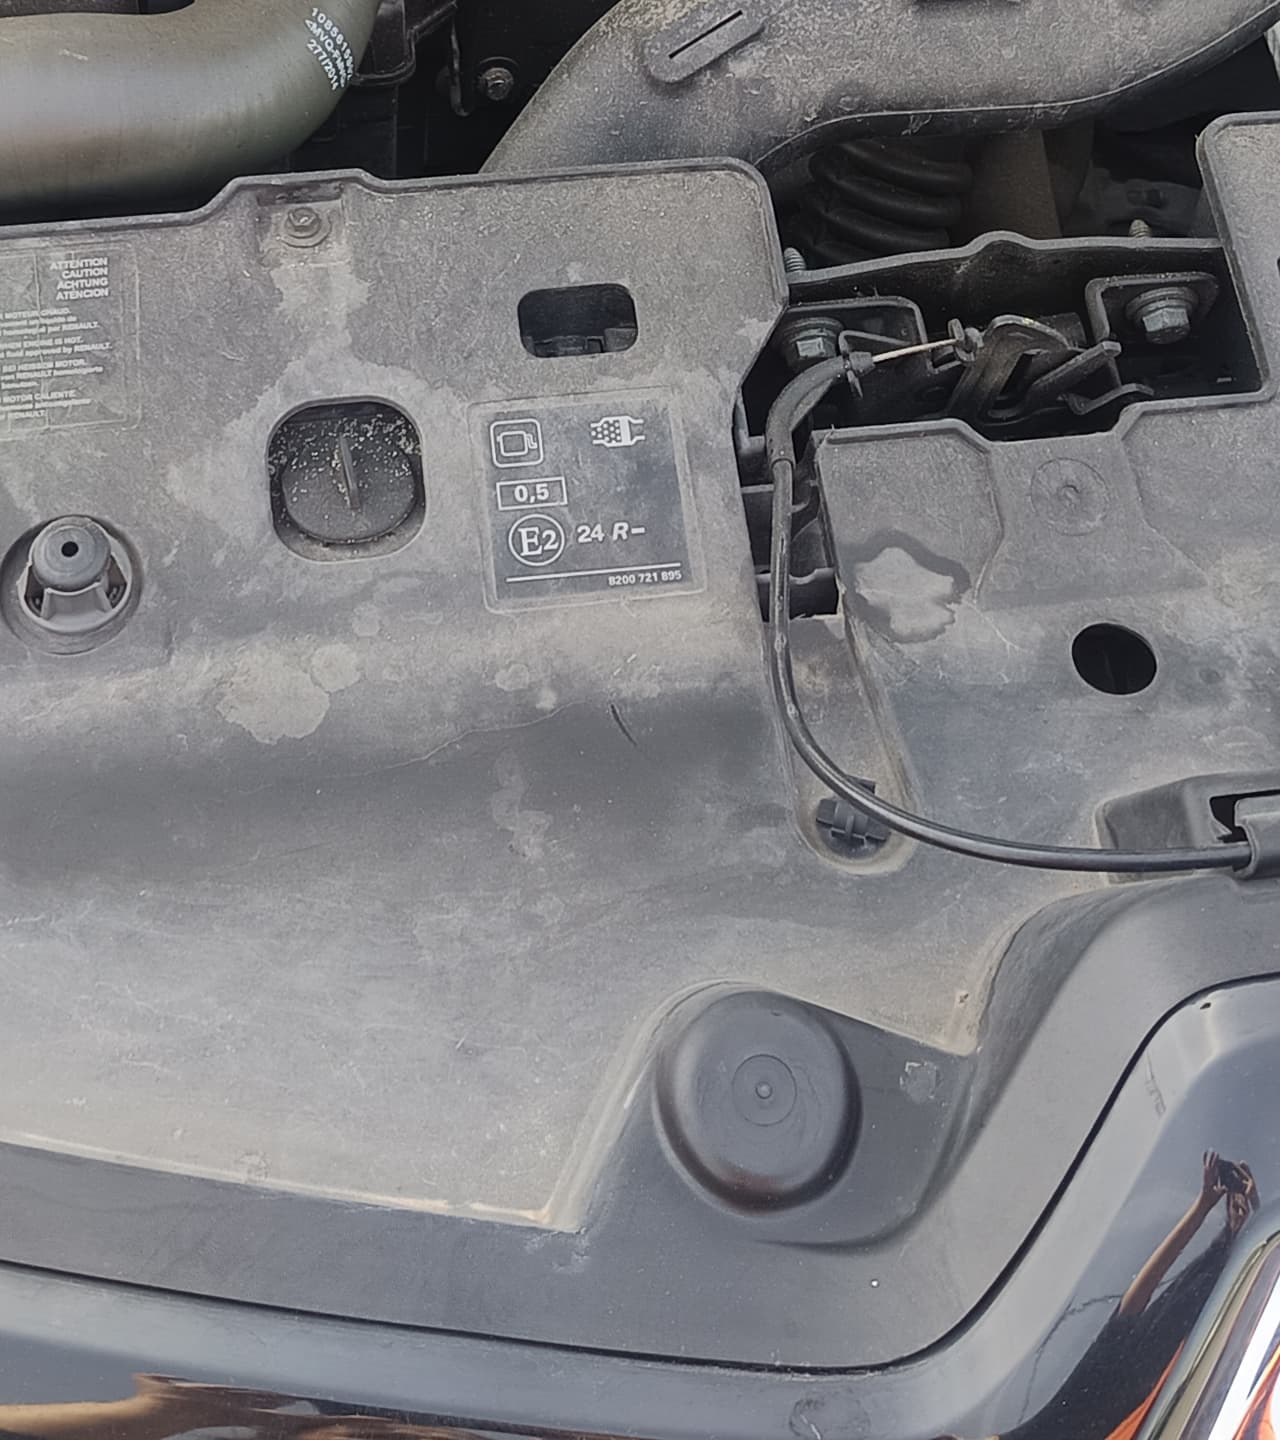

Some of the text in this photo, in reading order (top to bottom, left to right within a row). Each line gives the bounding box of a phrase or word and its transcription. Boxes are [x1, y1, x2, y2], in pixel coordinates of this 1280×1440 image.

[49, 257, 108, 270] ATTENTION
[62, 268, 108, 279] CAUTION
[57, 278, 108, 290] ACHTUNG
[56, 289, 109, 300] ATENCION
[514, 483, 550, 504] 0,5
[518, 526, 560, 557] E2
[577, 524, 605, 544] 24
[608, 570, 682, 586] 8200 721 895
